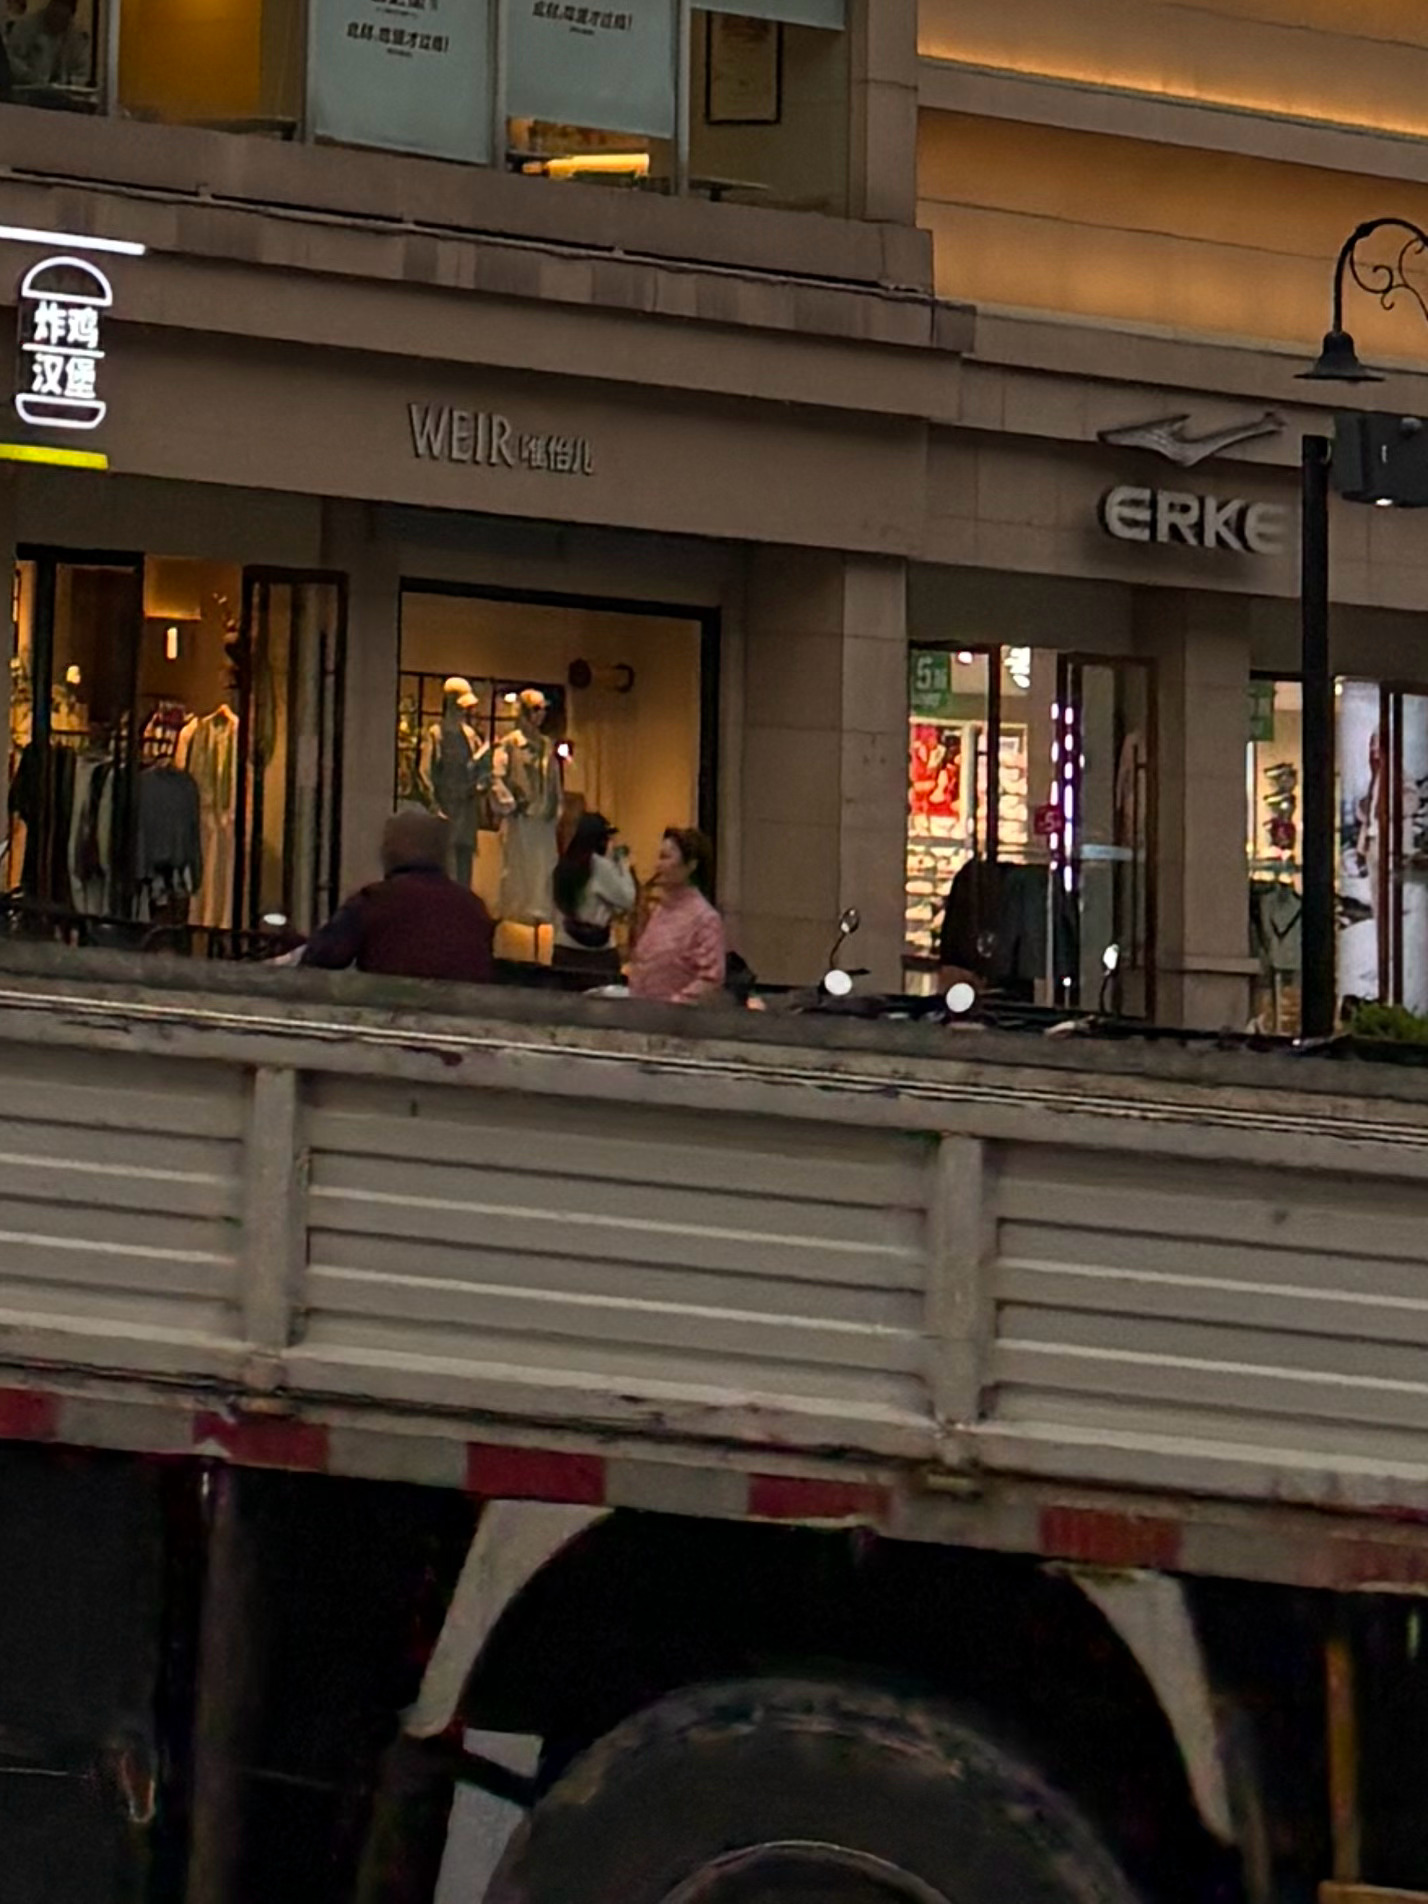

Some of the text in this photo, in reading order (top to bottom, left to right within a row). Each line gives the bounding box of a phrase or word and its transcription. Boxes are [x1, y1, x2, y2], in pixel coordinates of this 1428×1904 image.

[33, 299, 99, 349] 炸鸡
[31, 352, 97, 400] 汉堡
[407, 401, 513, 469] WEIR
[1099, 484, 1288, 556] ERKE
